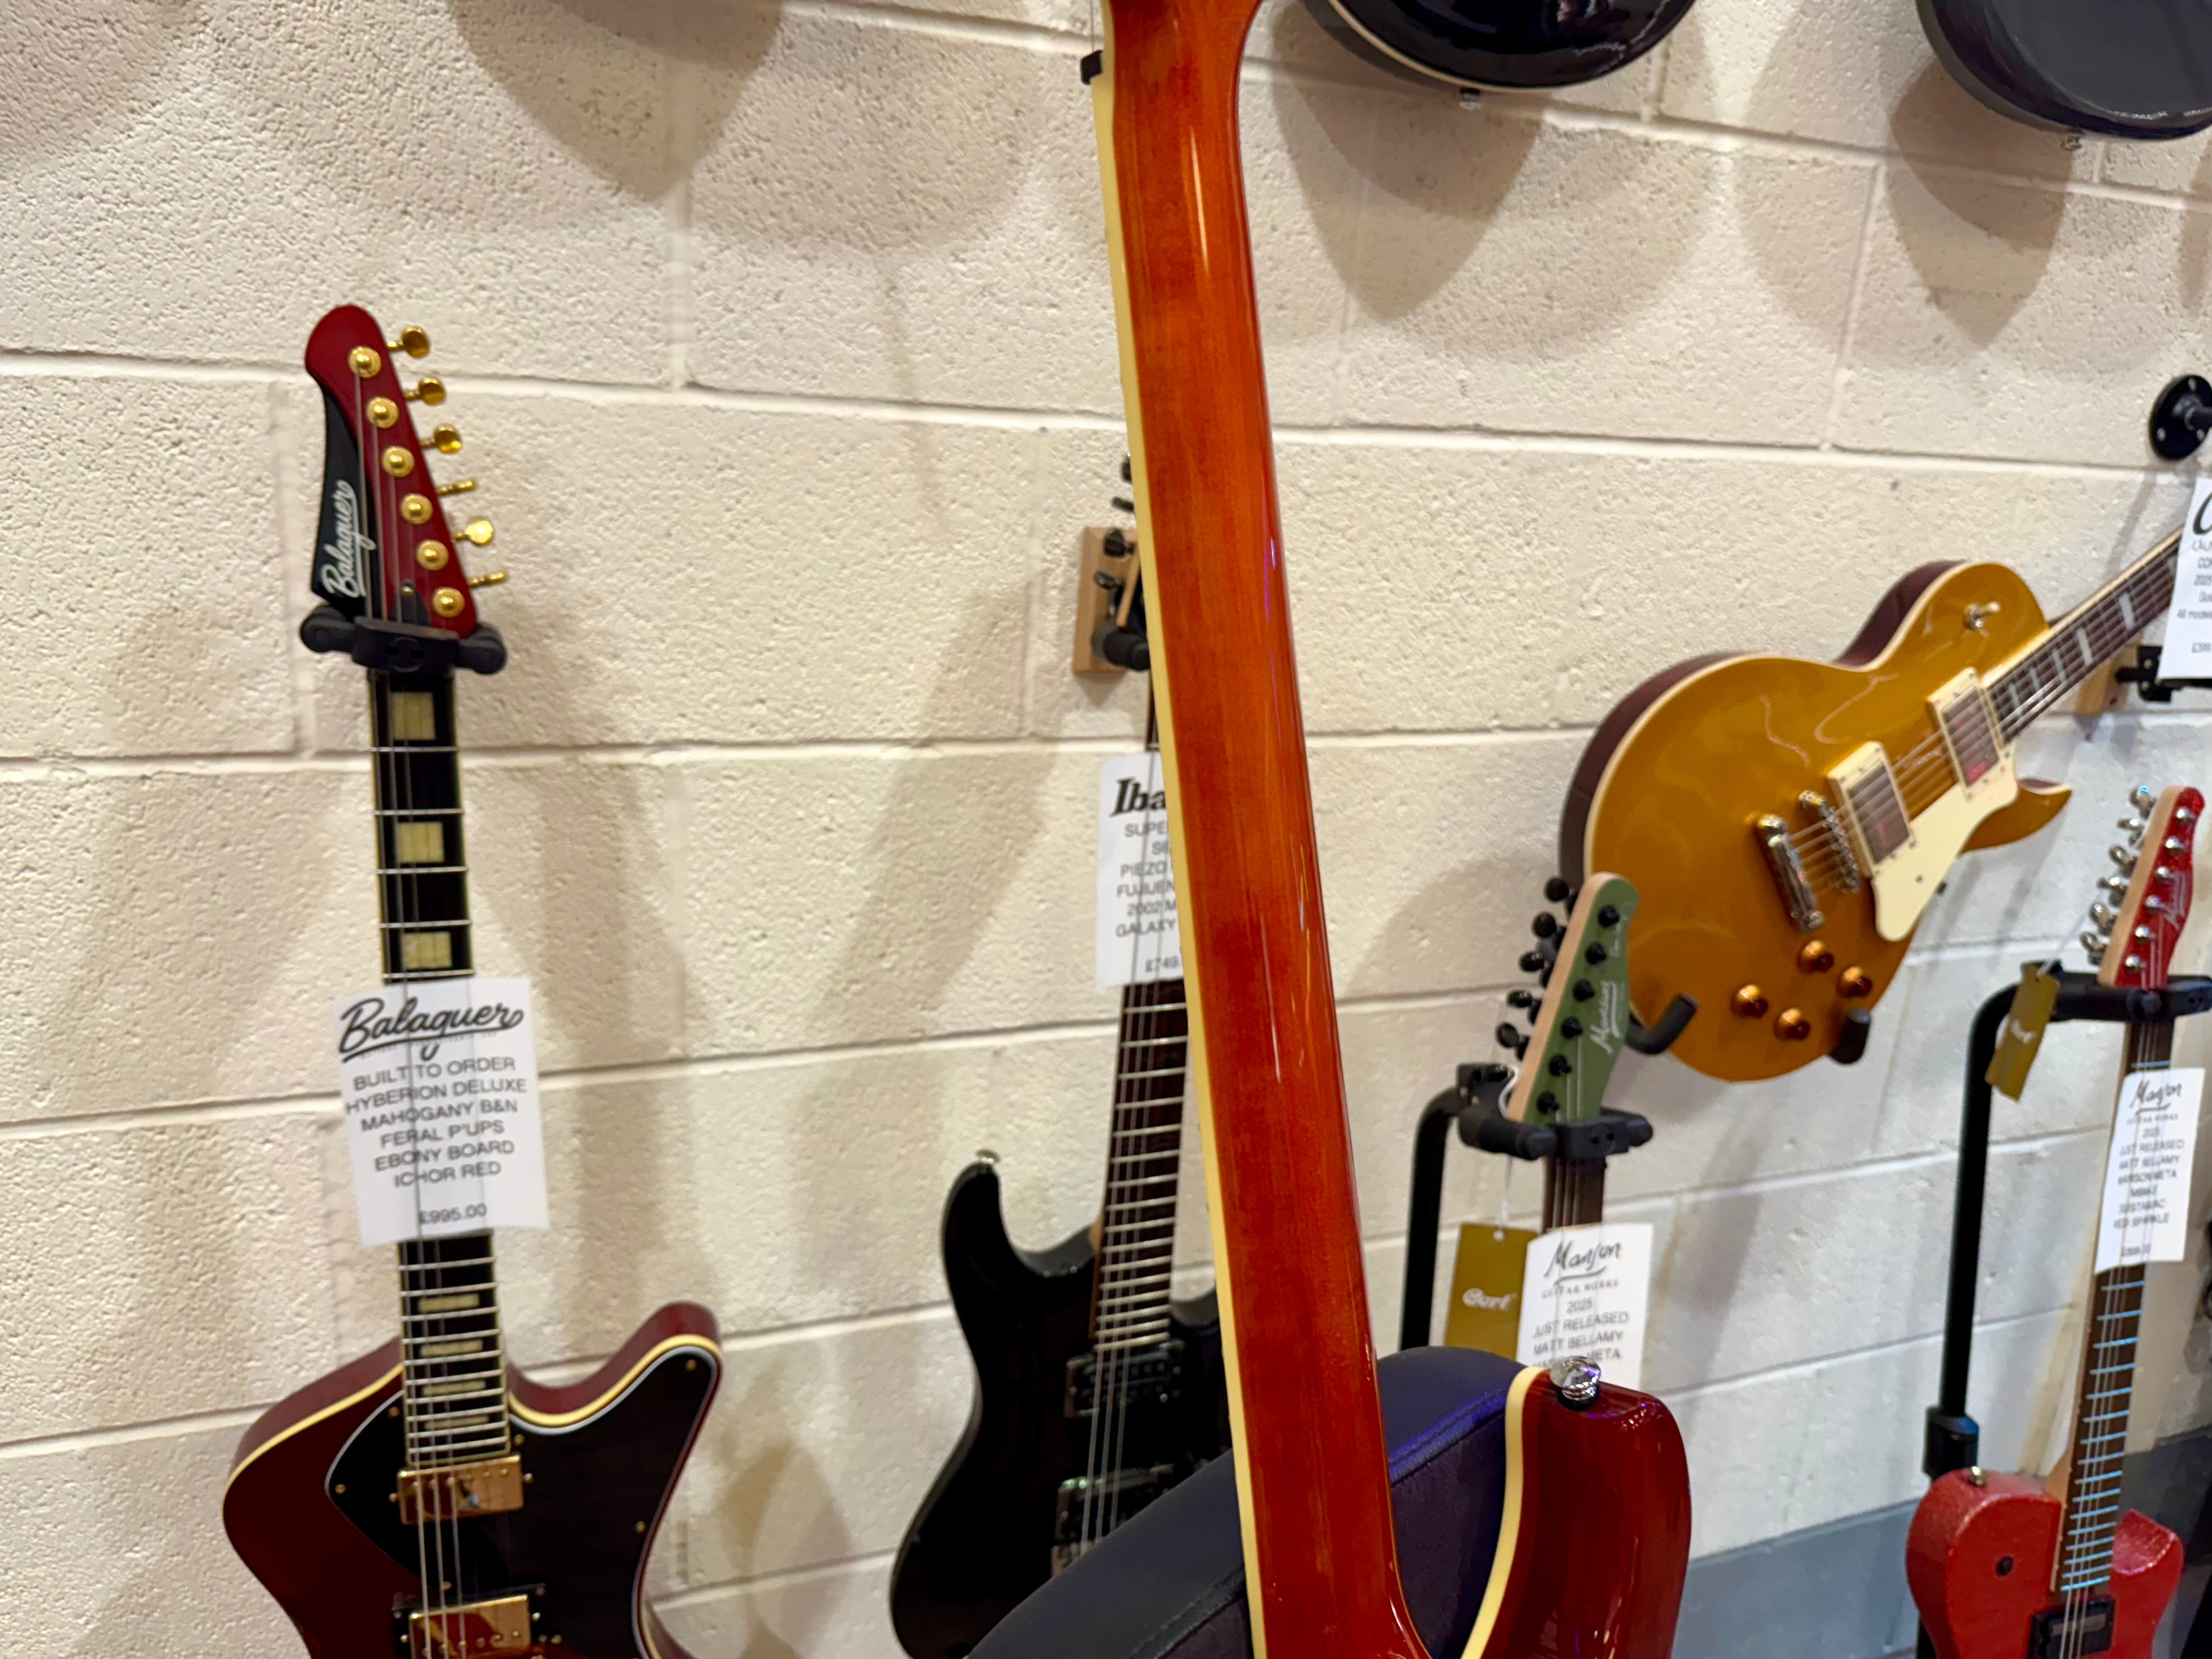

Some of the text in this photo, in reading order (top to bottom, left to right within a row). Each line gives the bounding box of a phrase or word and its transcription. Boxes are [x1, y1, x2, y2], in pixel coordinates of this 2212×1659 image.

[320, 479, 376, 598] Balaguer
[1110, 776, 1166, 816] Iba
[1124, 820, 1166, 838] SUPE
[338, 996, 524, 1063] Balaguer
[353, 1057, 516, 1091] BUILT TO ORDER
[452, 1079, 528, 1097] DELUXE
[361, 1098, 518, 1132] MAHOGANY B&N
[380, 1128, 443, 1148] FERAL
[374, 1140, 515, 1172] EBONY BOARD
[394, 1161, 501, 1188] ICHOR RED
[419, 1203, 488, 1225] £995.00
[1564, 1311, 1630, 1331] RELEASED
[1567, 1330, 1624, 1348] BELLAMY
